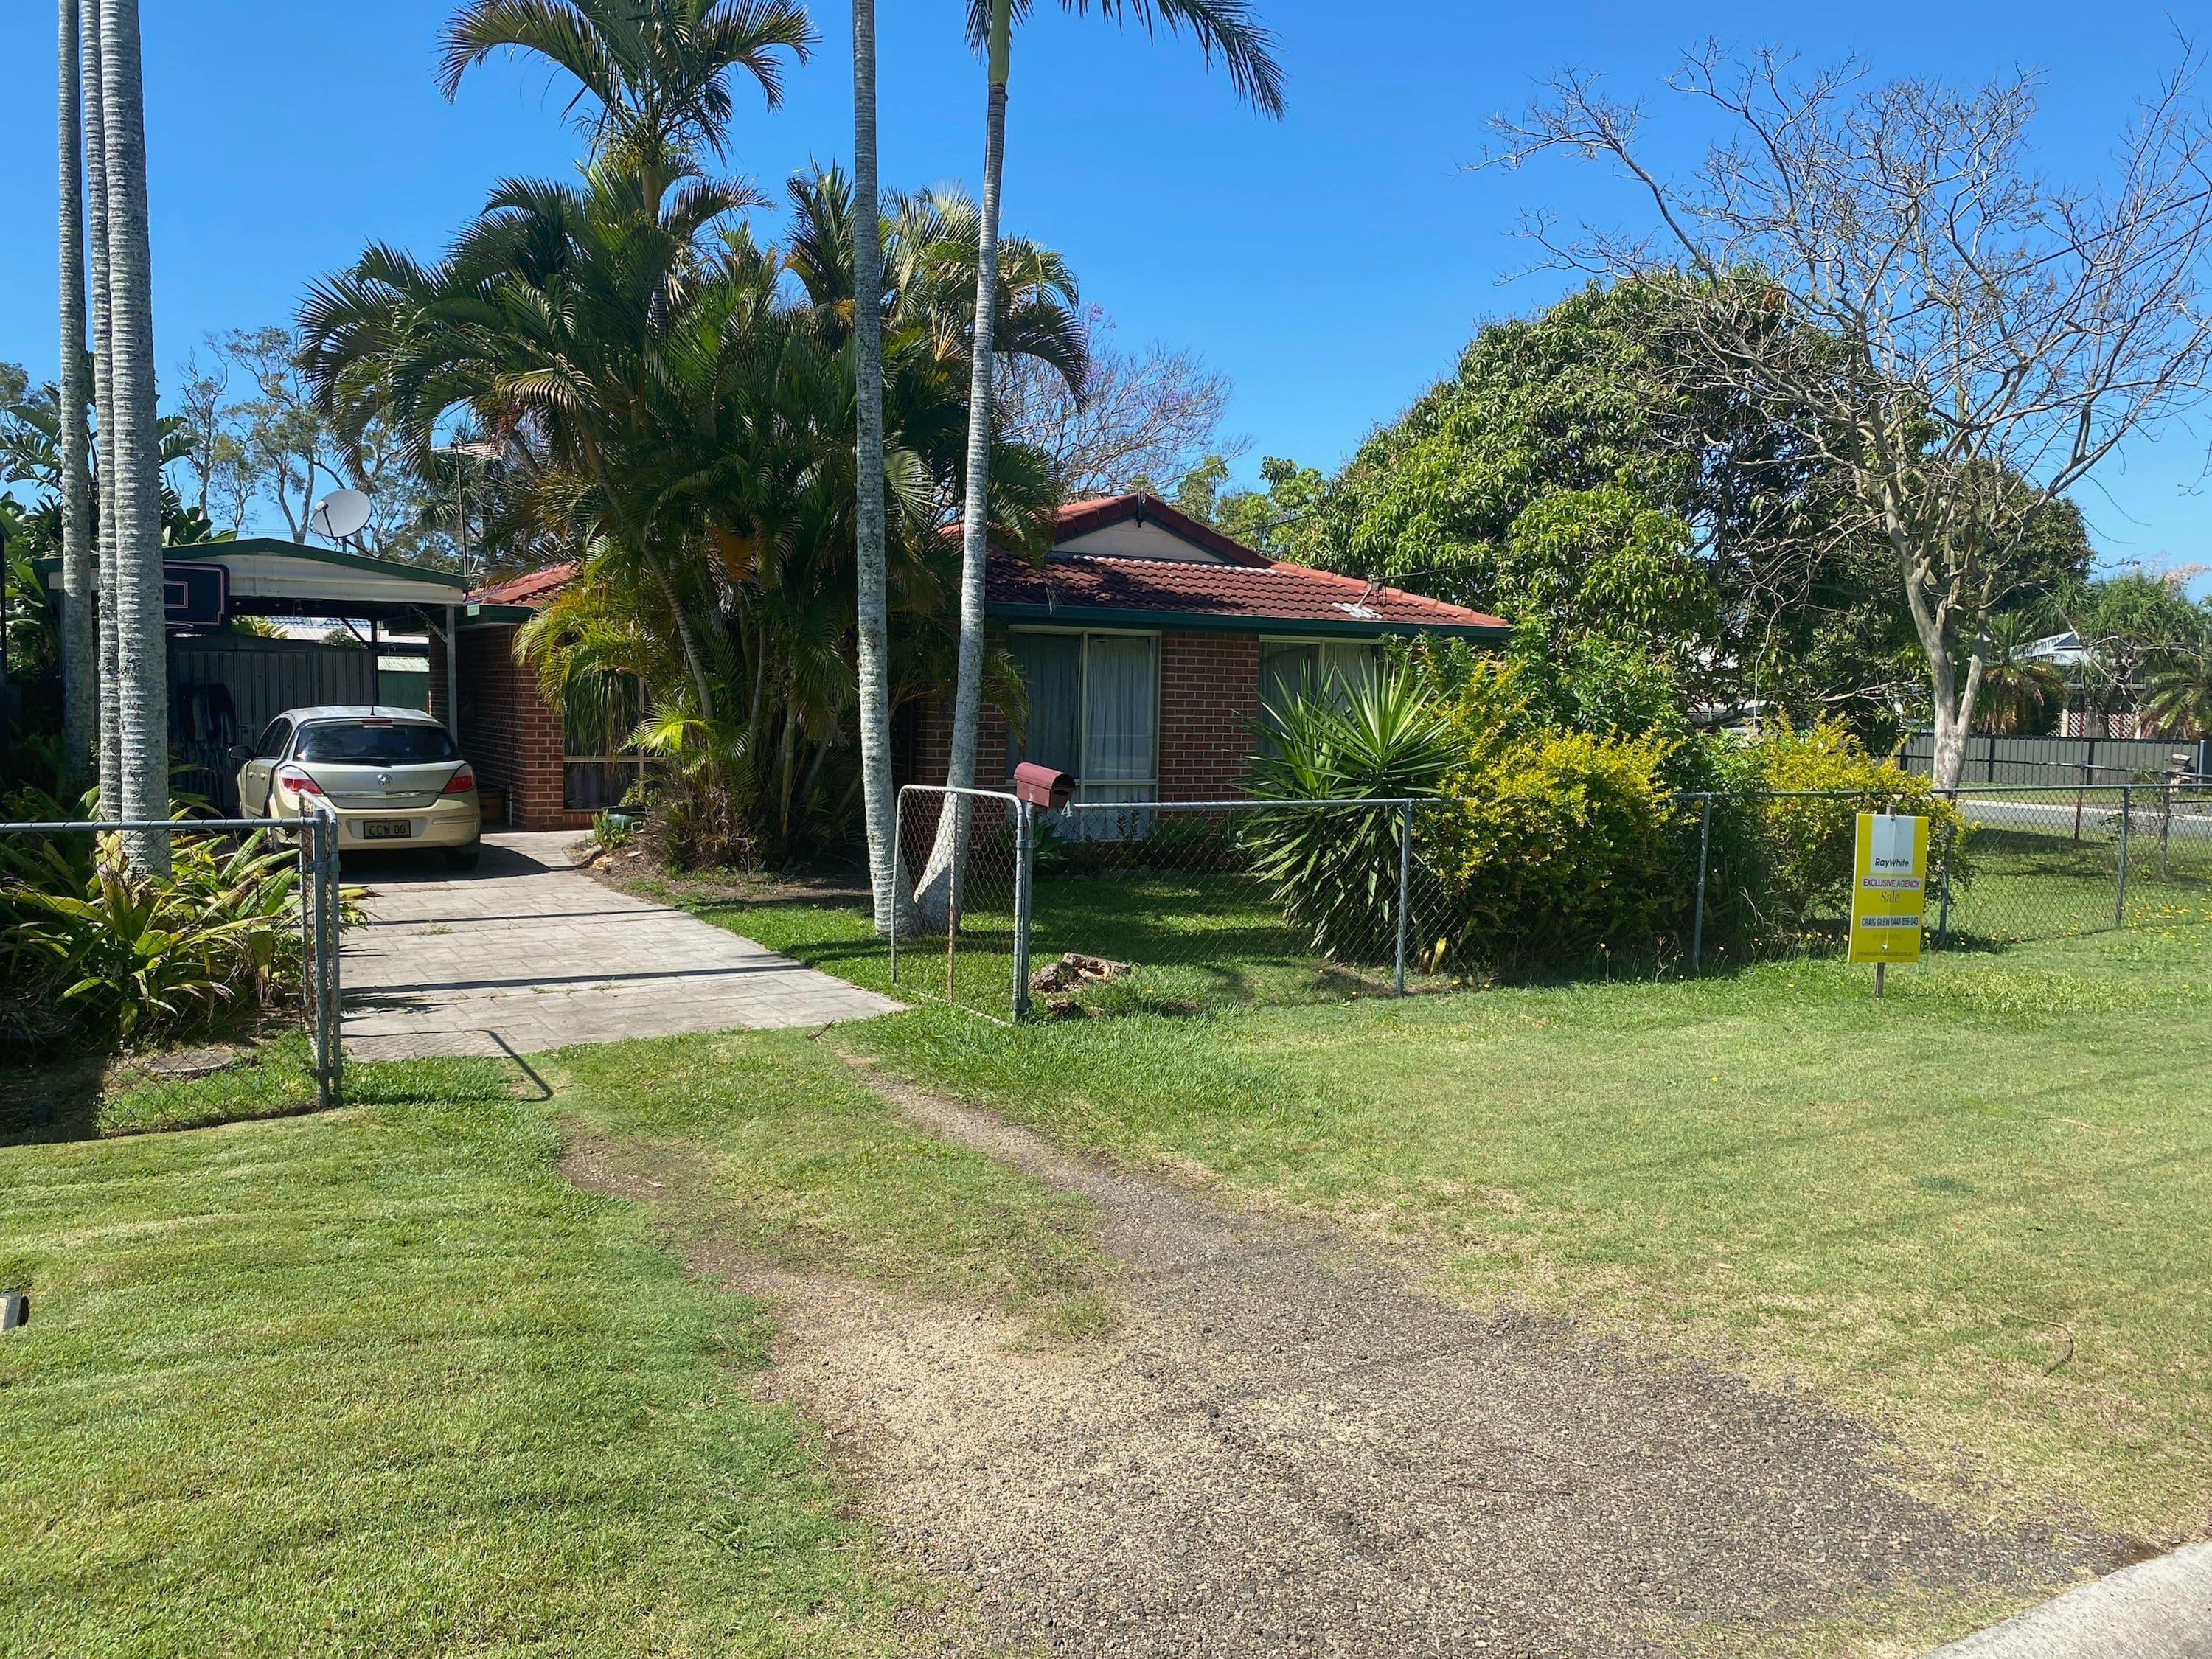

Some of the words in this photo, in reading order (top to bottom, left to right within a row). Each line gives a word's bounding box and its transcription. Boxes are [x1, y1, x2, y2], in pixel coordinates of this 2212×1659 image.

[1060, 800, 1073, 818] 4
[1863, 878, 1896, 887] EXCLUSIVE
[1896, 880, 1920, 888] AGENCY
[1880, 891, 1899, 903] Sale
[1862, 918, 1876, 927] CRAIG
